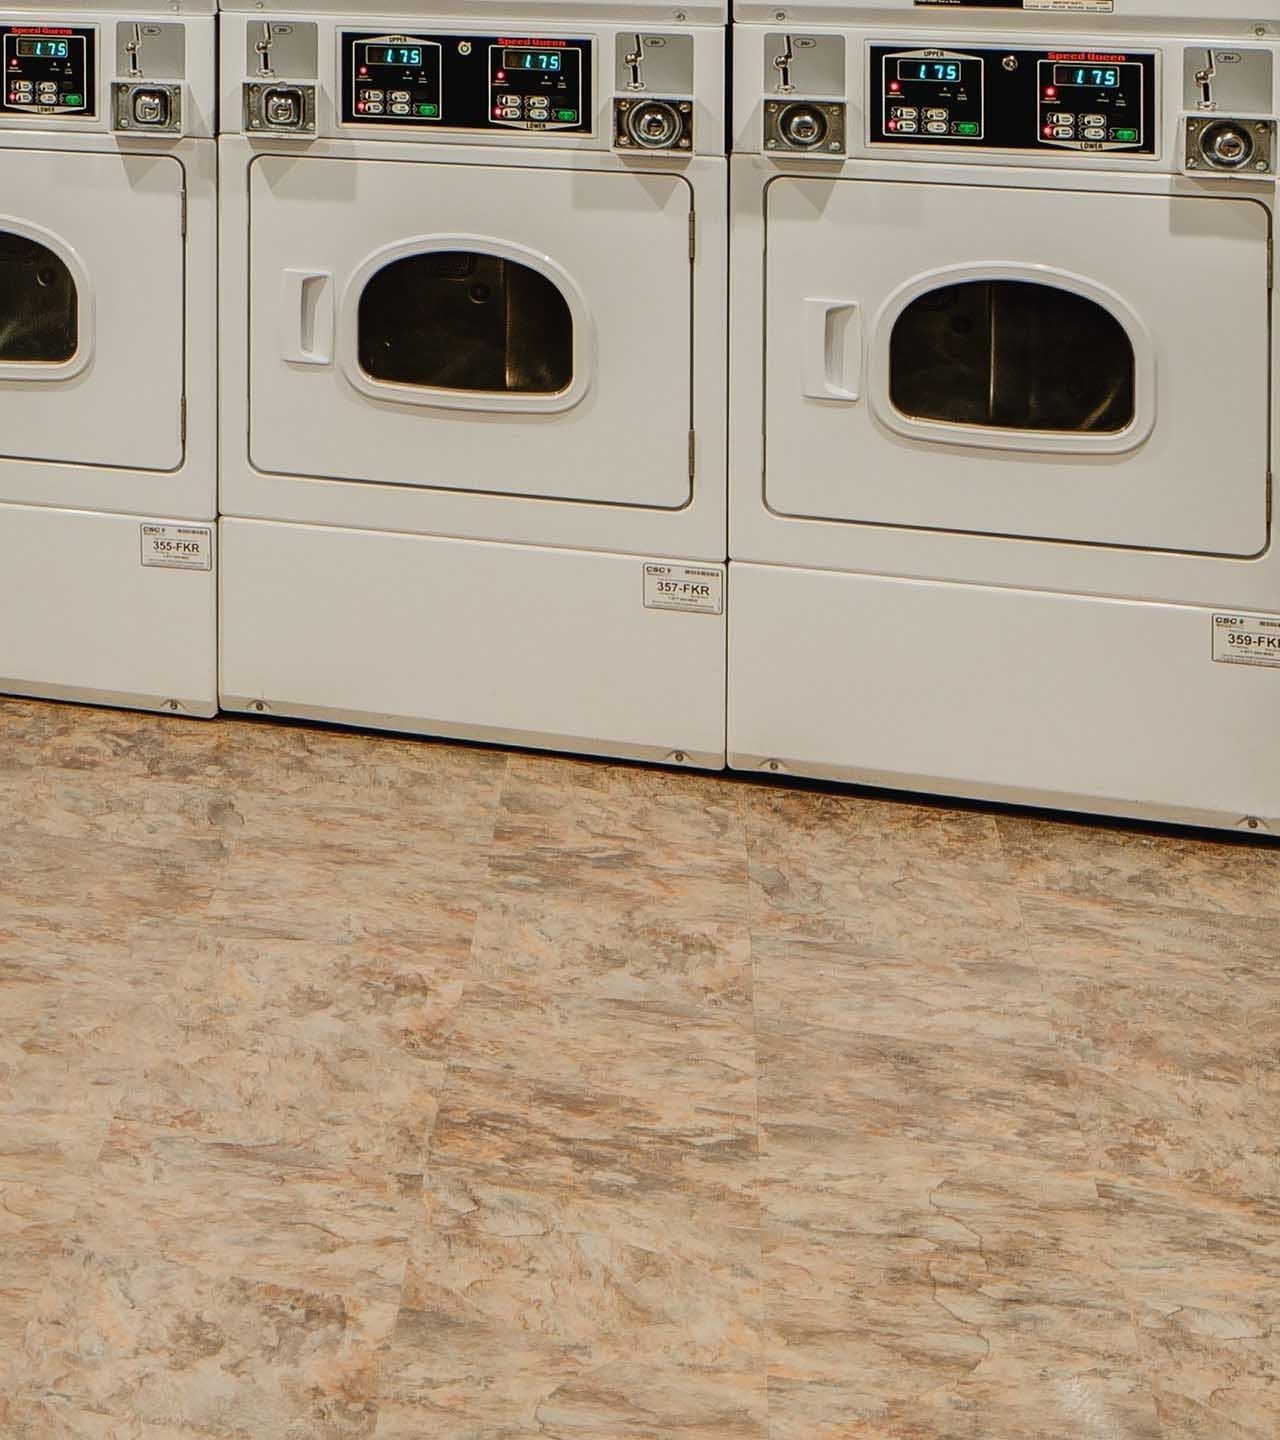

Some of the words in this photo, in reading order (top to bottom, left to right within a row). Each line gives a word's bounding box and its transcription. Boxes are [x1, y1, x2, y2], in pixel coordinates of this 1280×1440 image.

[12, 27, 40, 35] Speed
[498, 38, 530, 47] Speed
[1048, 51, 1085, 61] Speed
[1088, 52, 1126, 62] Queen
[153, 541, 199, 552] 355-FKR
[657, 582, 709, 595] 357-FKR
